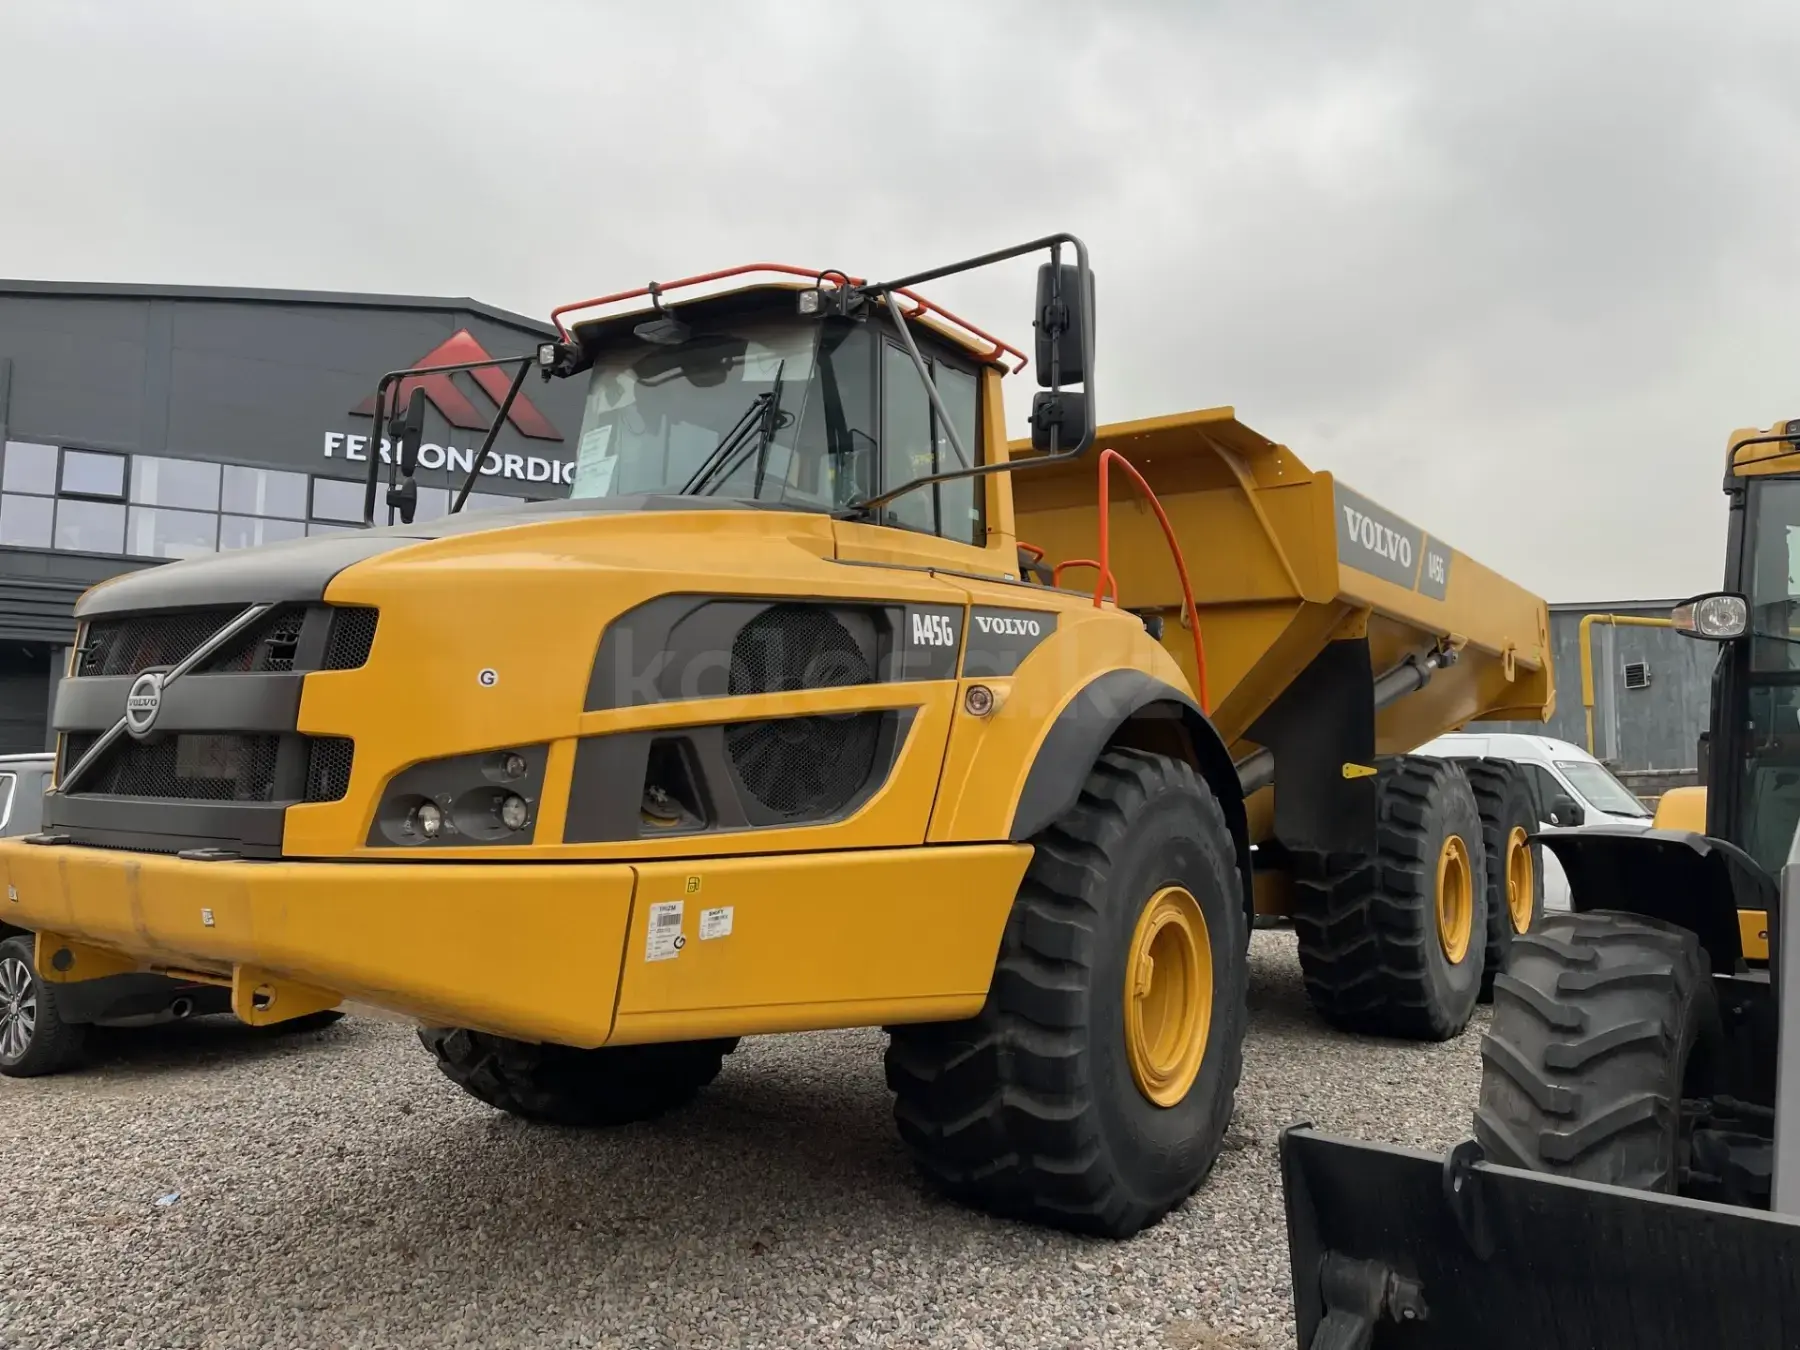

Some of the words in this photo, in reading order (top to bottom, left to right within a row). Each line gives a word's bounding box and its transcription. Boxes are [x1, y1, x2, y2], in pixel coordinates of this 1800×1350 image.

[1343, 505, 1412, 568] VOLVO
[912, 613, 954, 647] A45G
[975, 616, 1041, 637] VOLVO
[480, 670, 495, 685] G
[128, 698, 158, 707] VOLVO
